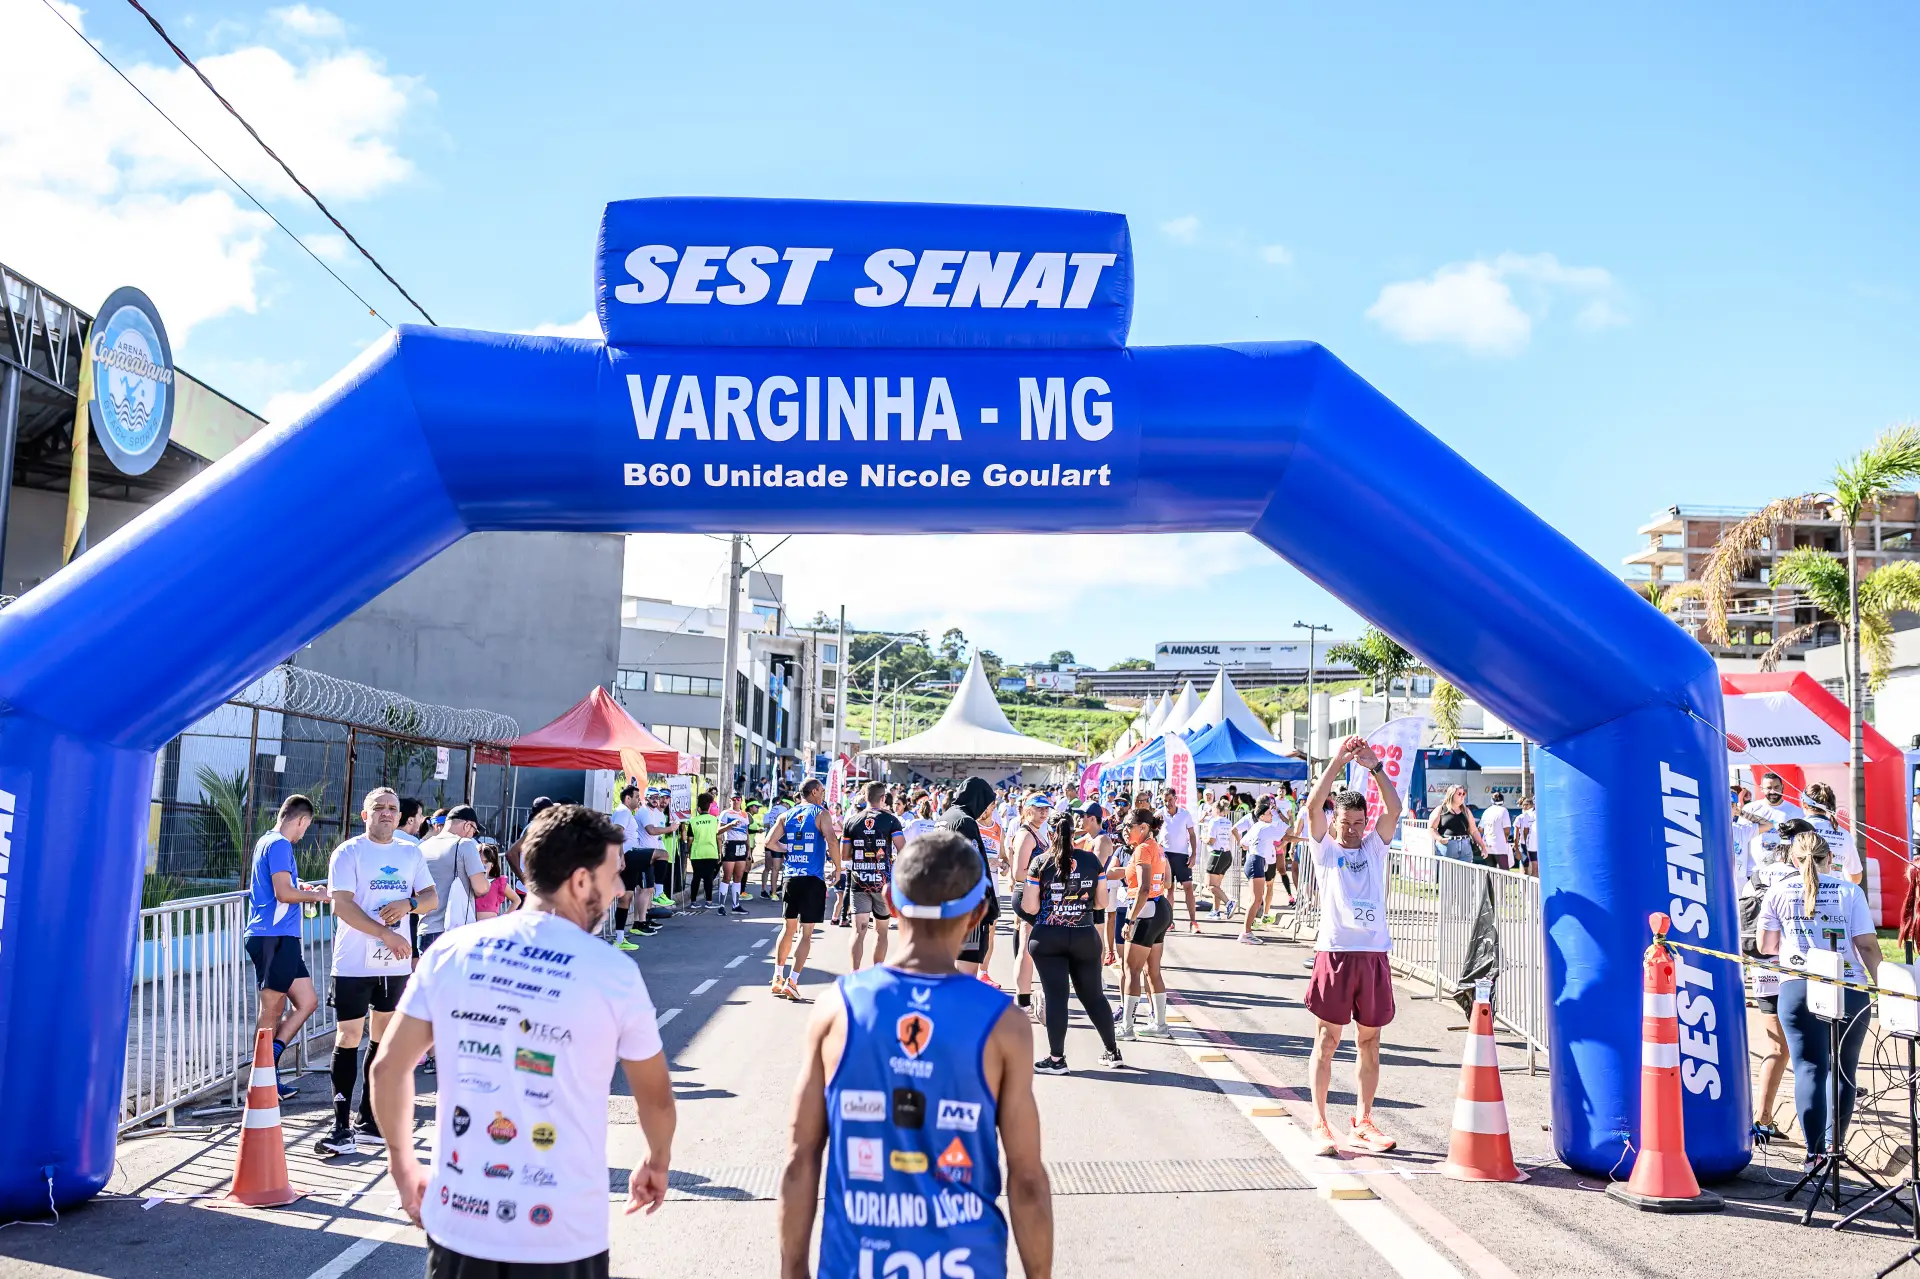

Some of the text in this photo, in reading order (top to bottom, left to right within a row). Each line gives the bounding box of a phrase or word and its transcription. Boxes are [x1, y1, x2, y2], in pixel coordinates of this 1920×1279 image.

[614, 245, 1117, 309] SEST SENAT
[90, 331, 172, 386] Copacabana
[117, 341, 147, 356] ARENA
[626, 375, 1113, 441] VARGINHA - MG
[103, 400, 158, 447] BEACH SPORTS
[623, 463, 1111, 487] B60 Unidade Nicole Goulart
[1171, 645, 1221, 655] MINASUL
[1747, 735, 1821, 748] ONCOMINAS
[1660, 761, 1710, 938] SENAT
[1354, 908, 1376, 922] 26
[475, 937, 576, 965] SEST SENAT
[1672, 955, 1721, 1100] SEST
[458, 1040, 502, 1057] ATMA
[845, 1187, 983, 1228] ADRIANO LÚCIO
[860, 1236, 891, 1251] Grupo
